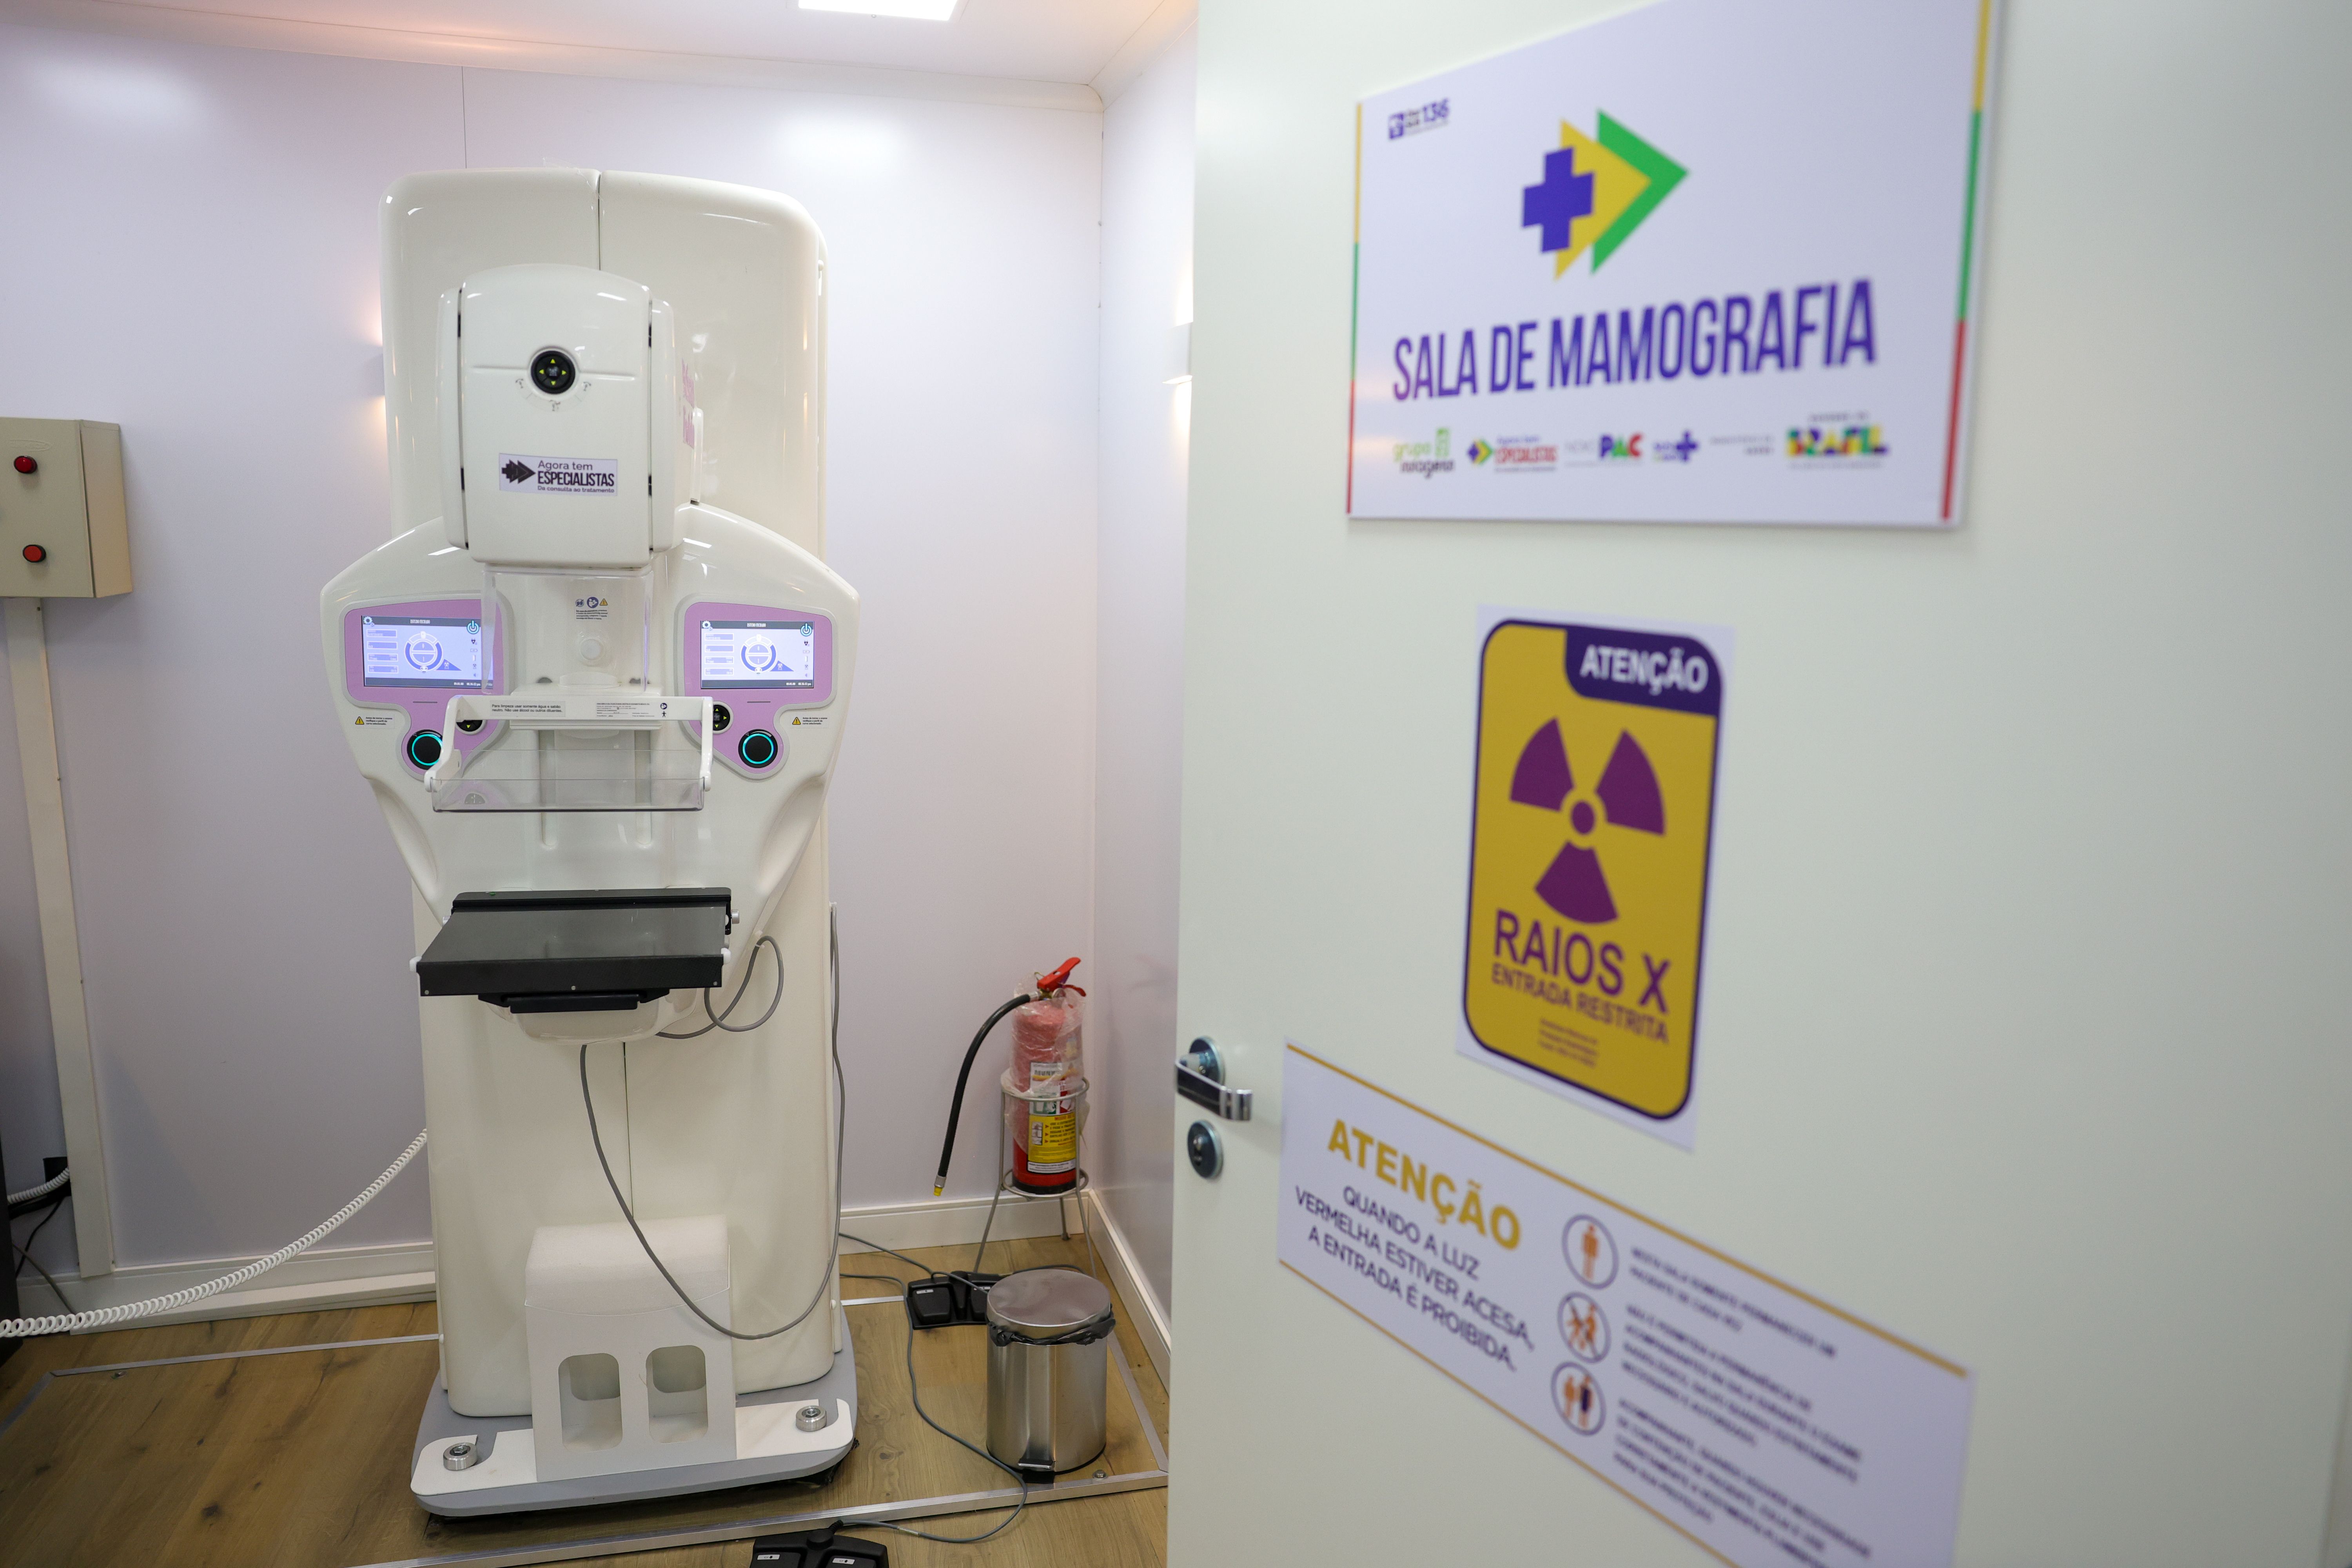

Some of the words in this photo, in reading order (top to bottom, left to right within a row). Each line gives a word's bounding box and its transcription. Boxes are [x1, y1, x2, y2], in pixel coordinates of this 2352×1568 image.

[1393, 329, 1477, 401] SALA
[1491, 321, 1538, 392] DE
[1548, 278, 1876, 389] MAMOGRAFIA
[537, 471, 614, 486] ESPECIALISTAS
[538, 460, 568, 471] Agora
[572, 462, 593, 470] tem
[1599, 433, 1644, 460] PAC
[1579, 644, 1709, 696] ATENÇÃO
[1494, 908, 1624, 996] RAIOS
[1639, 952, 1670, 1015] X
[1492, 962, 1571, 1008] ENTRADA
[1576, 992, 1669, 1045] RESTRITA
[1327, 1118, 1520, 1250] ATENÇÃO
[1295, 1185, 1380, 1254] VERMELHA
[1386, 1240, 1459, 1301] ESTIVER
[1309, 1225, 1320, 1246] A
[1324, 1233, 1403, 1299] ENTRADA
[1407, 1283, 1417, 1308] É
[1343, 1185, 1420, 1244] QUANDO
[1424, 1233, 1438, 1257] A
[1443, 1241, 1480, 1281] LUZ
